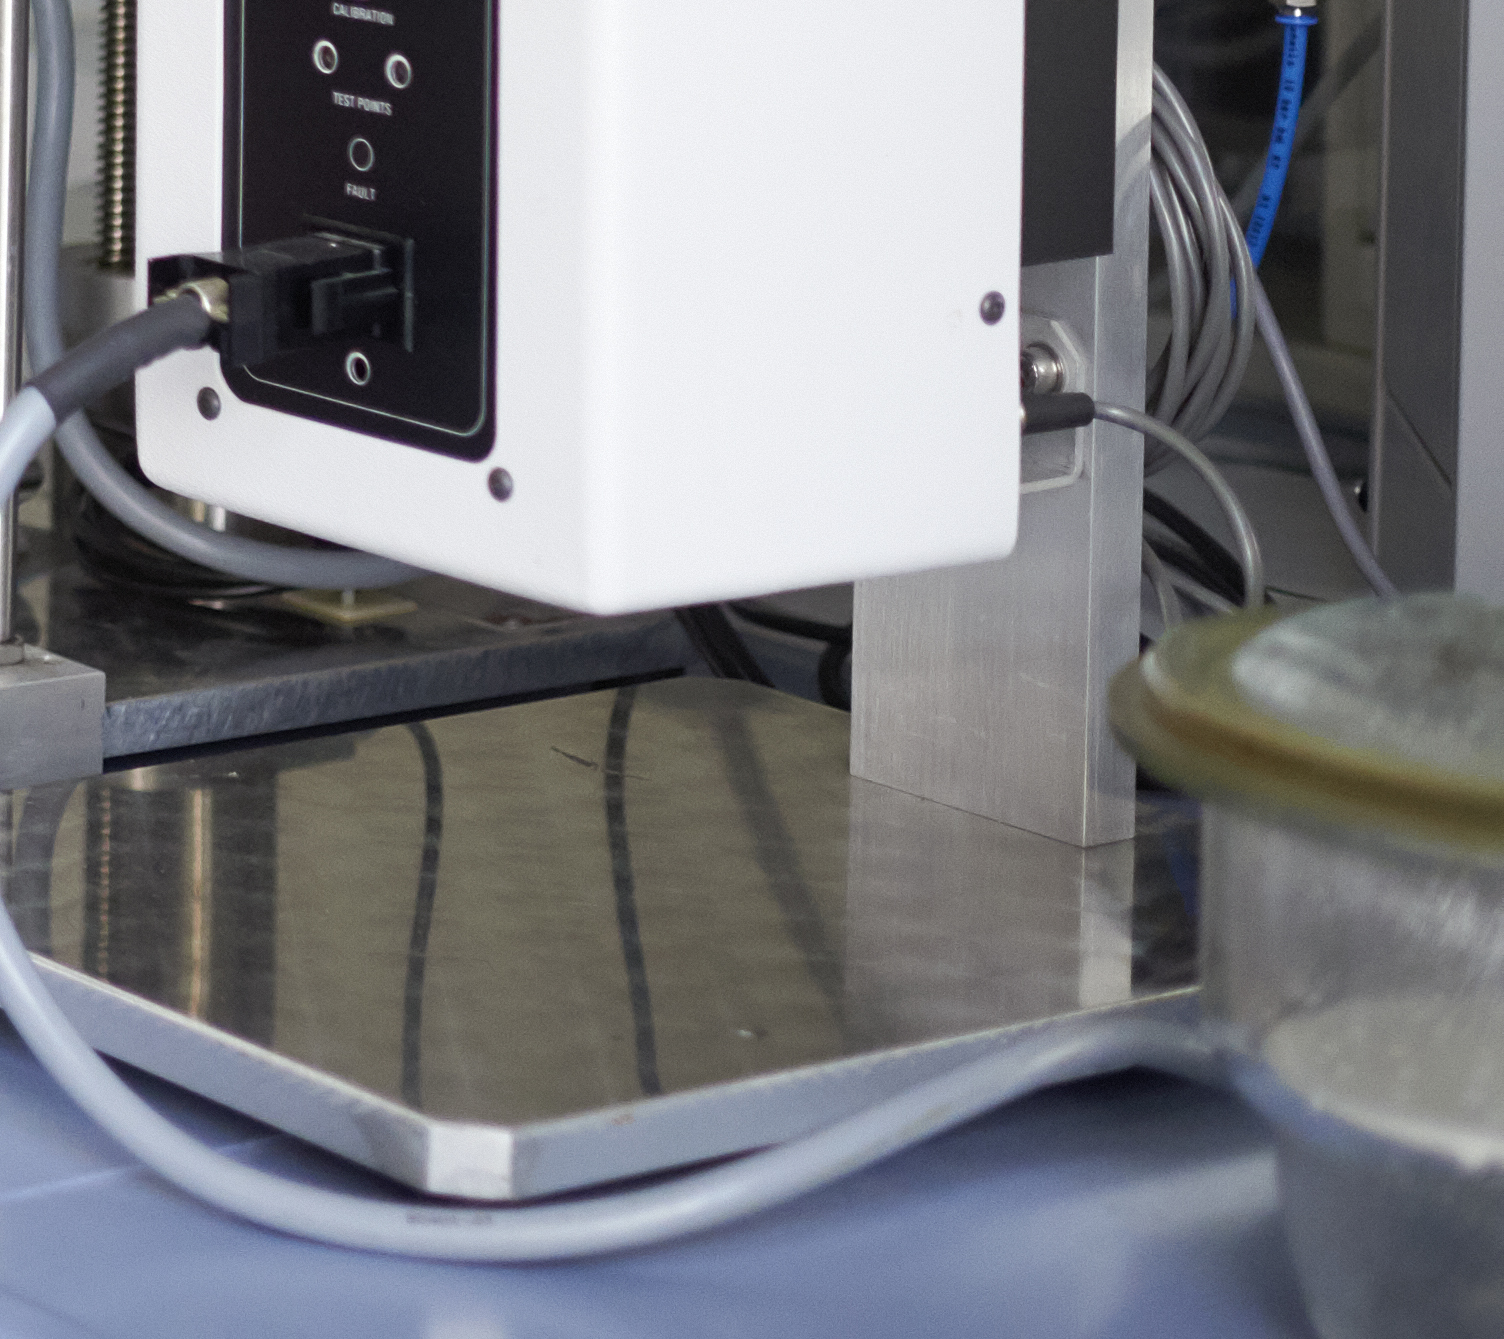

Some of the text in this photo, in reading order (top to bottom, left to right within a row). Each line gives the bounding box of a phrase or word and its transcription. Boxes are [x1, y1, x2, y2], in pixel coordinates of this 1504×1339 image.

[332, 2, 395, 25] CALIBRATION
[332, 92, 393, 116] TEST POINTS
[346, 184, 376, 201] FAULT
